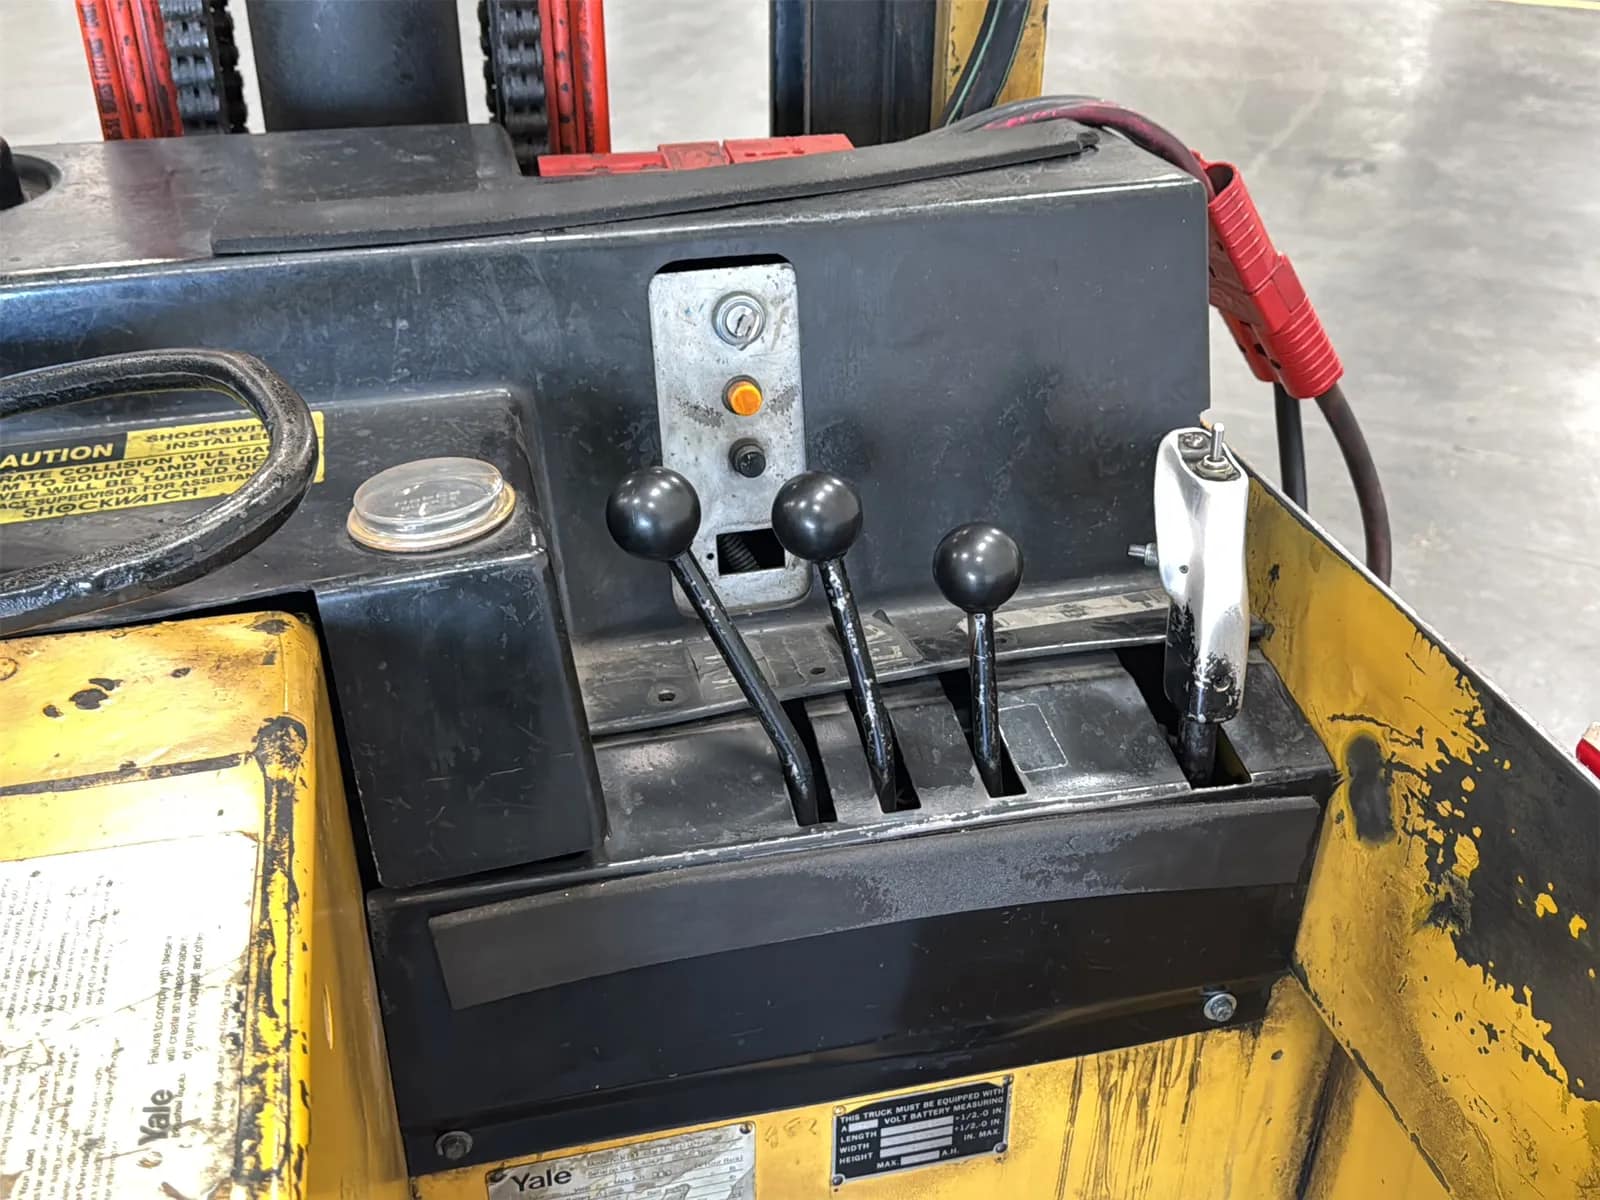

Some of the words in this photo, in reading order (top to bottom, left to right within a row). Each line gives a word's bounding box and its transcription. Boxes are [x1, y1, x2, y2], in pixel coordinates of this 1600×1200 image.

[27, 479, 56, 488] TO
[153, 462, 197, 473] AND
[60, 456, 172, 476] COLLISION
[180, 450, 229, 462] WILL
[34, 487, 137, 505] SUPERVISOR
[143, 482, 175, 491] FOR
[47, 483, 97, 496] WILL
[105, 477, 134, 488] BE
[143, 466, 228, 482] TURNED
[138, 1089, 174, 1146] Yale
[841, 1114, 860, 1124] THIS
[863, 1108, 892, 1119] TRUCK
[896, 1103, 920, 1113] MUST
[923, 1100, 934, 1109] BE
[937, 1092, 980, 1106] EQUIPPED
[982, 1087, 1004, 1097] WITH
[884, 1114, 908, 1124] VOLT
[911, 1107, 951, 1120] BATTERY
[953, 1096, 1004, 1111] MEASURING
[839, 1152, 874, 1165] HEIGHT
[978, 1128, 1000, 1138] MAX.
[840, 1131, 877, 1143] LENGTH
[840, 1142, 870, 1153] WIDTH
[877, 1160, 900, 1169] MAX.
[511, 1168, 572, 1192] Yale
